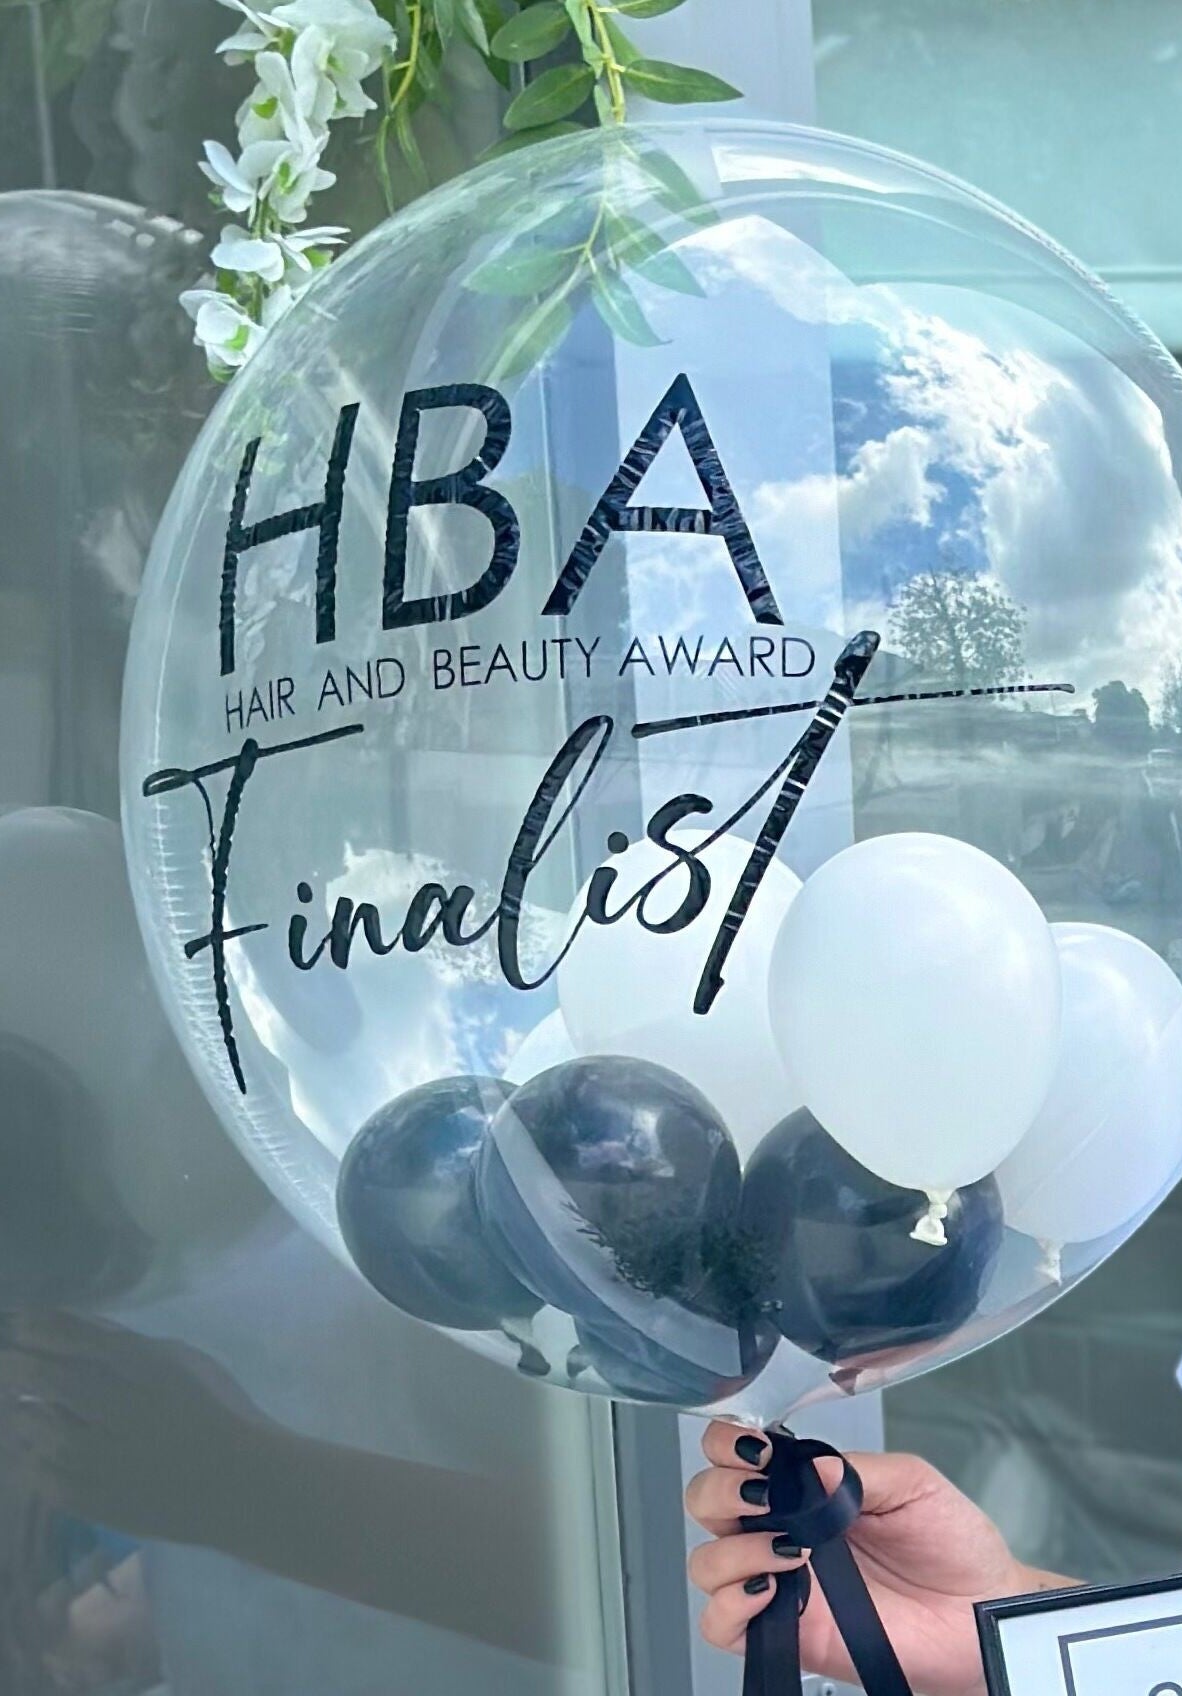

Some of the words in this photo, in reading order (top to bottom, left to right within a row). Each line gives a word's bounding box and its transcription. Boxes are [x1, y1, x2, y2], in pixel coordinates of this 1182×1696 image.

[219, 372, 785, 677] HBA
[225, 676, 296, 734] HAIR
[317, 657, 406, 711] AND
[432, 635, 601, 690] BEAUTY
[618, 634, 816, 679] AWARD
[143, 629, 1076, 1095] Finalist
